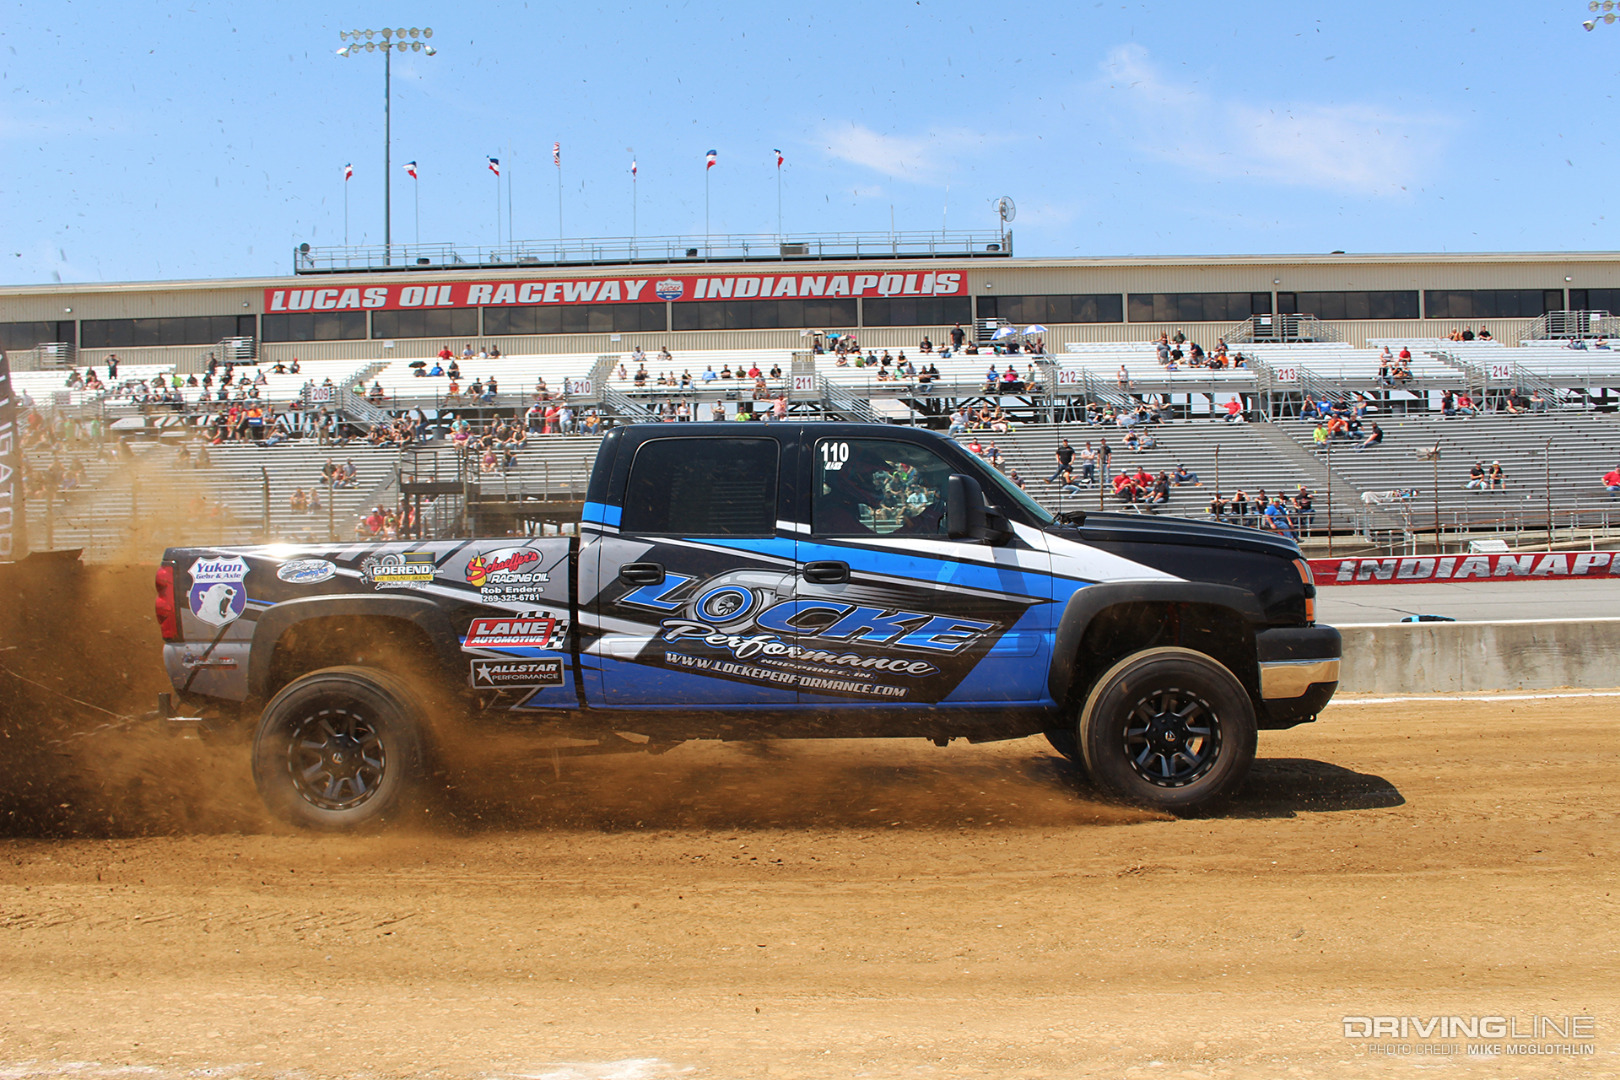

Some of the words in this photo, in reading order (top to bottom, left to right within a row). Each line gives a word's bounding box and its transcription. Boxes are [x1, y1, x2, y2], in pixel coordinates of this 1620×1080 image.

[693, 272, 962, 299] INDIANAPOLIS
[270, 288, 389, 311] LUCAS
[399, 285, 455, 307] OIL
[466, 280, 649, 305] RACEWAY
[1059, 371, 1076, 383] 212
[1278, 368, 1295, 380] 213
[1493, 365, 1509, 377] 214
[574, 381, 591, 393] 210
[795, 377, 812, 389] 211
[312, 388, 329, 400] 209
[820, 442, 849, 462] 110
[196, 562, 243, 573] Yukon
[466, 551, 539, 582] Schaeffer's
[490, 573, 532, 584] RACING
[532, 572, 550, 582] OIL
[480, 586, 502, 594] Rob
[482, 594, 540, 603] 269-325-6781
[619, 572, 997, 652] LOCKE
[475, 622, 549, 635] LANE
[470, 635, 545, 644] AUTOMOTIVE
[661, 620, 935, 674] Performance
[490, 664, 558, 673] ALLSTAR
[665, 652, 907, 697] WWW.LOCKEPERFORMANCE.COM
[491, 673, 559, 681] PERFORMANCE
